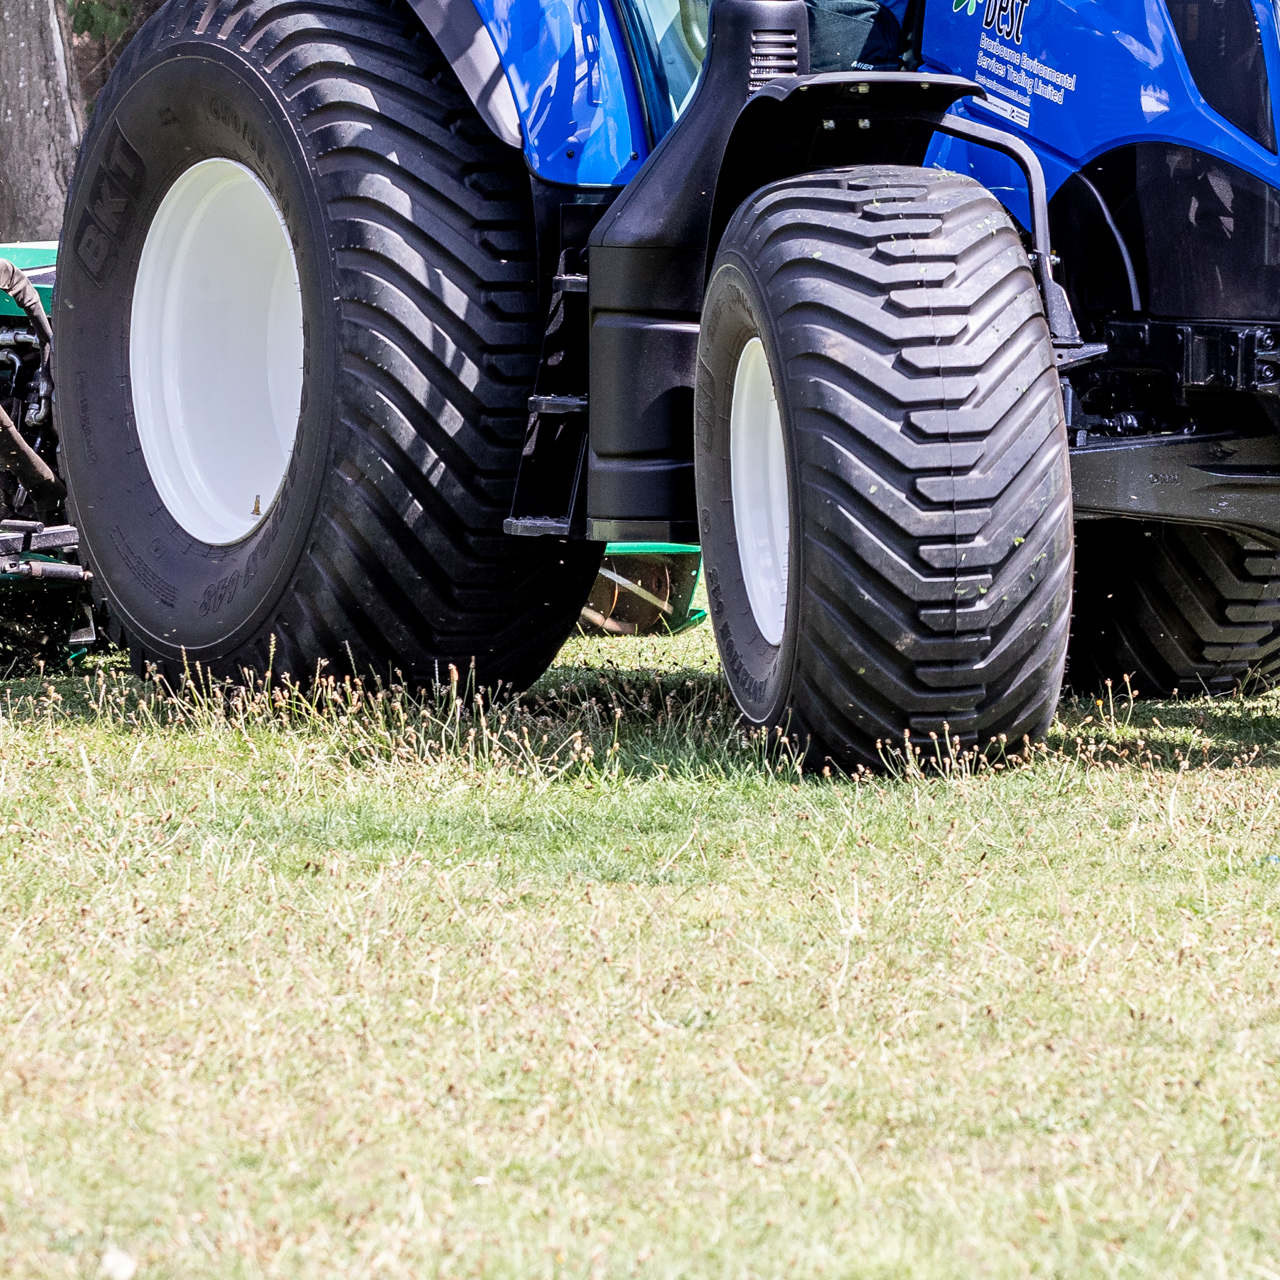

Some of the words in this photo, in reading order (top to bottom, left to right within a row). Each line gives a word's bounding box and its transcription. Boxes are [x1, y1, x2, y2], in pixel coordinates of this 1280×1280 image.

[977, 50, 1006, 77] Services
[1007, 65, 1034, 95] Trading
[1034, 77, 1064, 104] Limited
[979, 32, 1021, 65] Broxbourne
[1020, 52, 1076, 91] Environmental
[76, 133, 139, 274] BKT
[198, 568, 241, 617] 648
